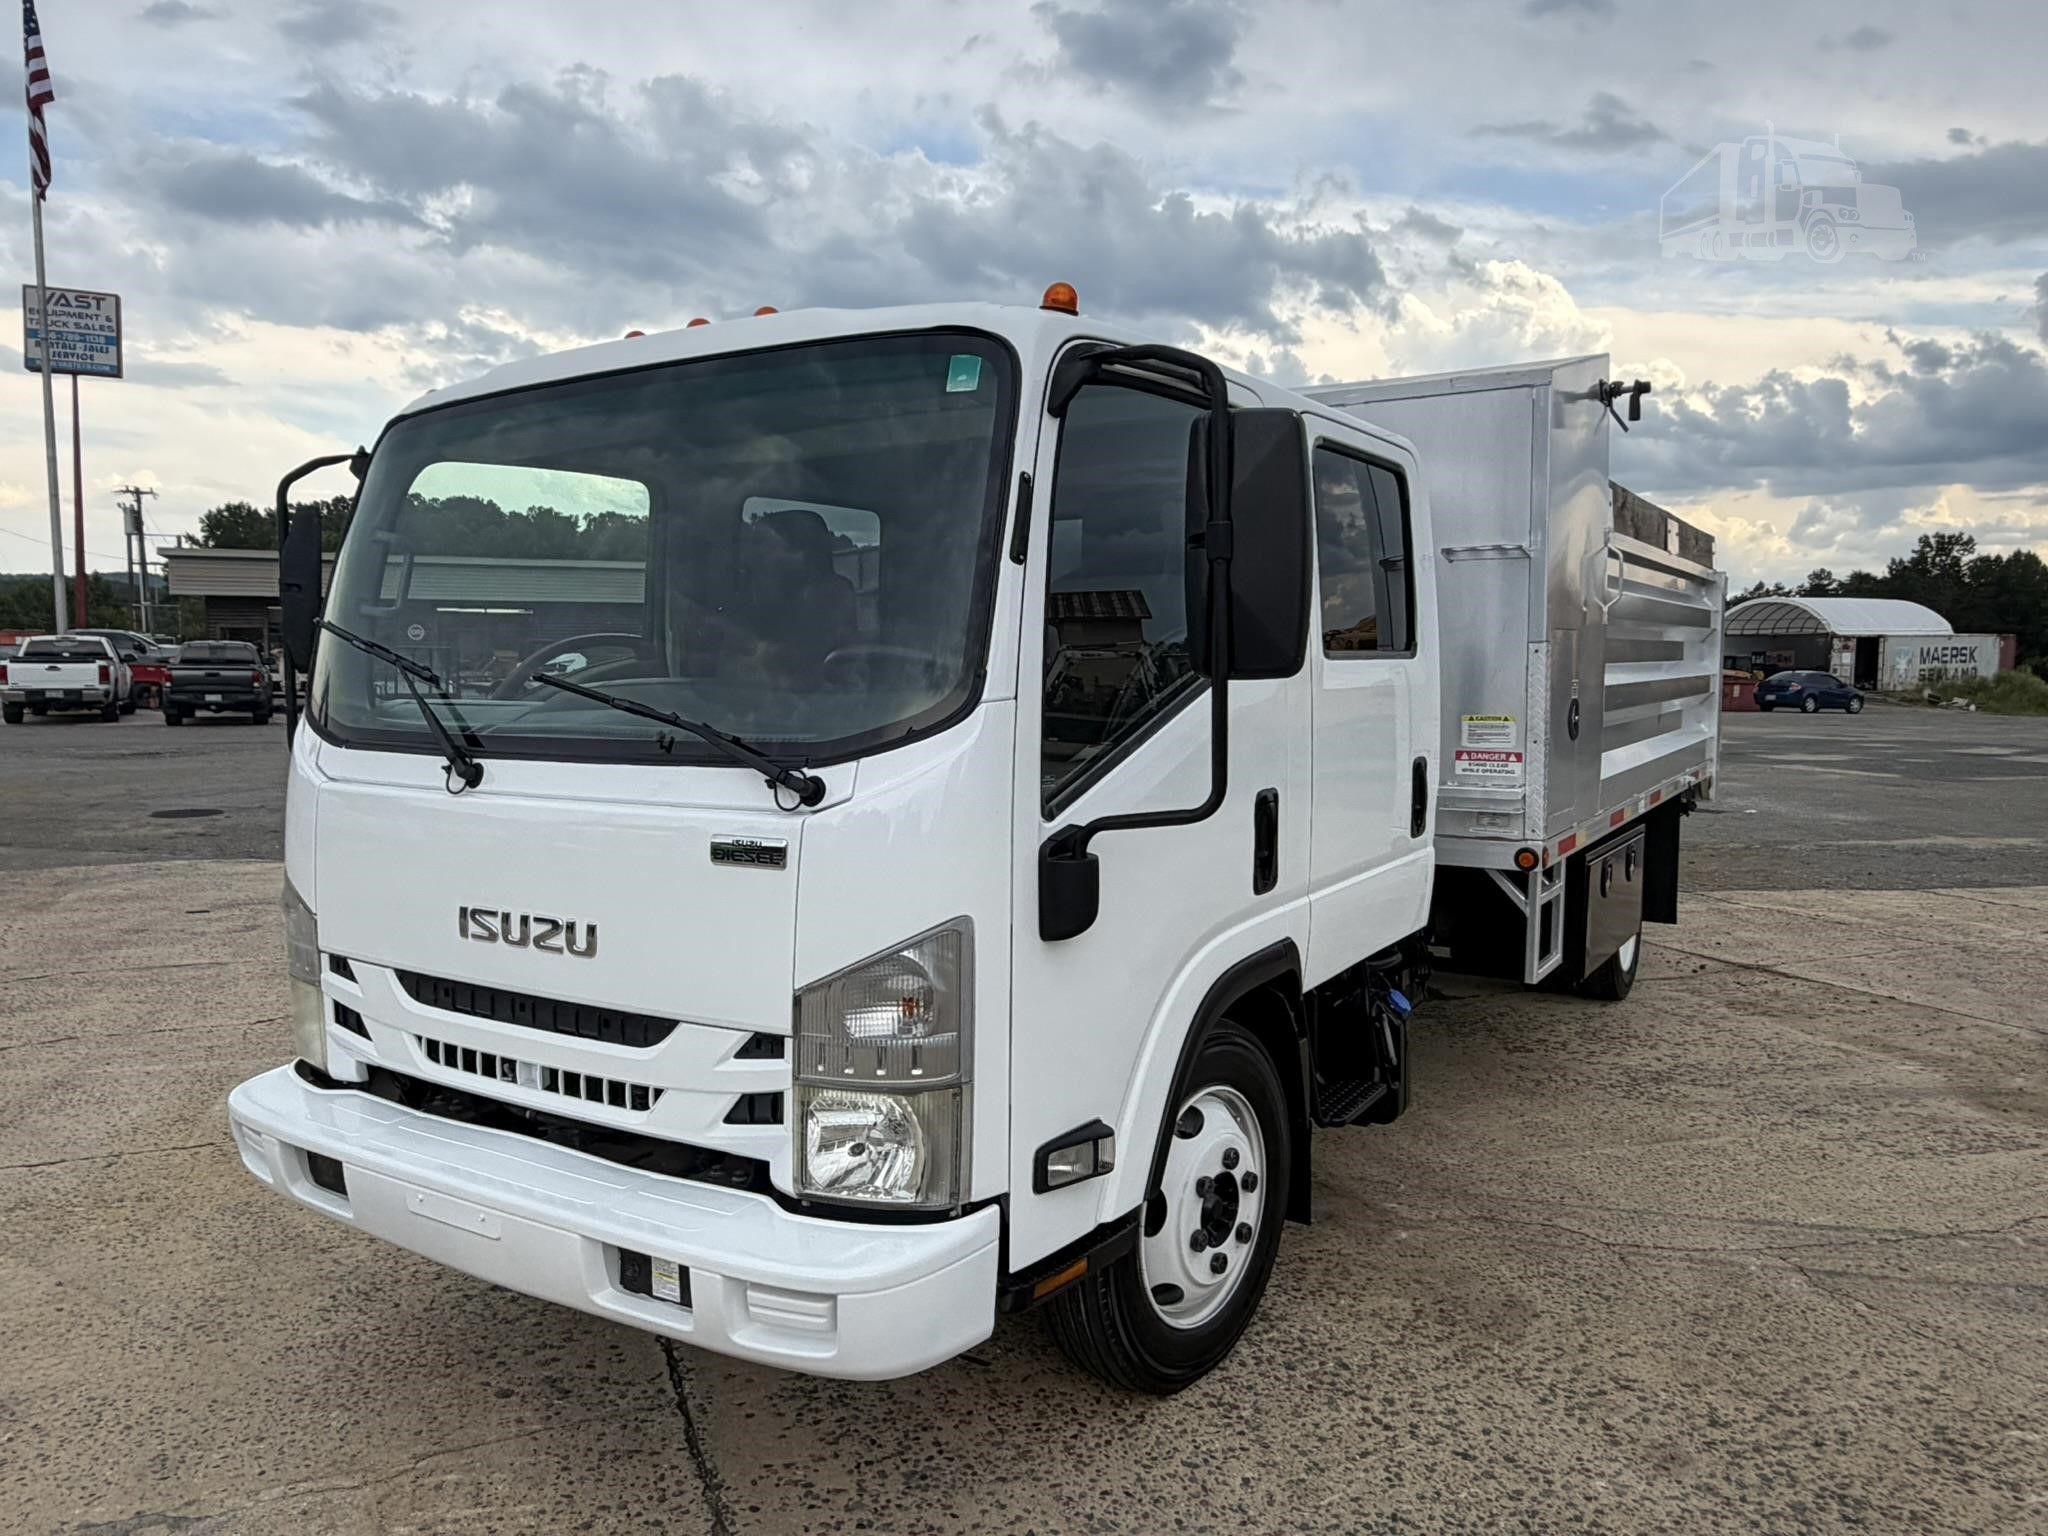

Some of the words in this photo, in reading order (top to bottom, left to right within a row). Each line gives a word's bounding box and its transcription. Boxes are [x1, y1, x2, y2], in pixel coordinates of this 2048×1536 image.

[74, 321, 115, 333] SALES
[1919, 645, 1978, 665] MAERSK
[1470, 752, 1506, 761] DANGER
[459, 906, 598, 959] ISUZU
